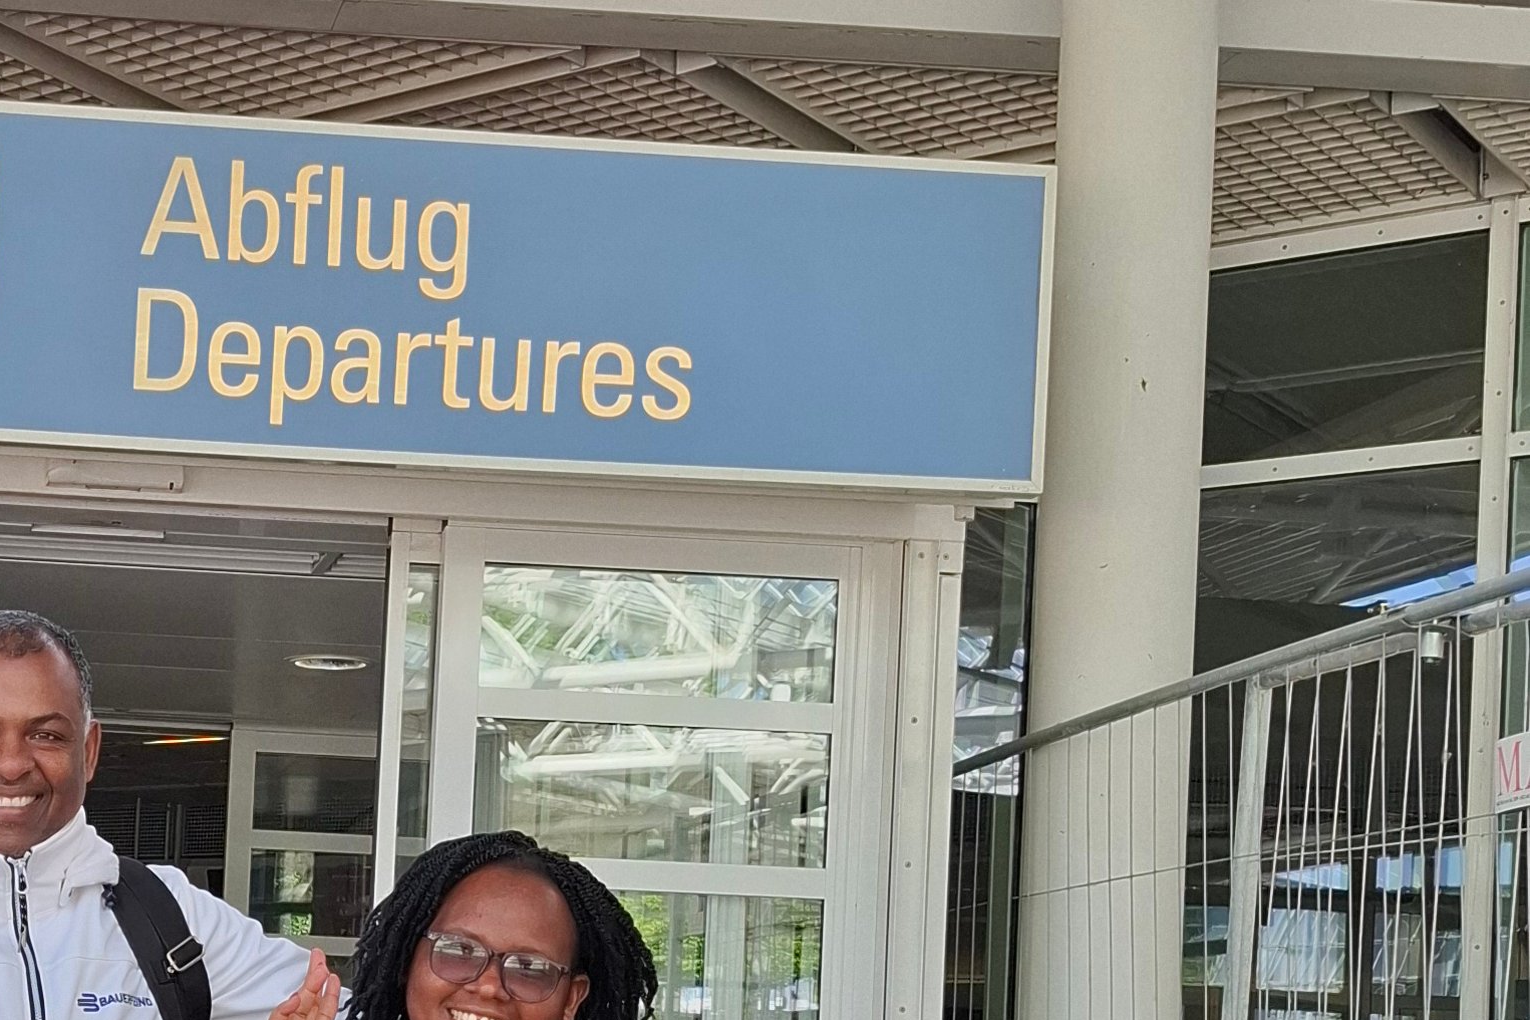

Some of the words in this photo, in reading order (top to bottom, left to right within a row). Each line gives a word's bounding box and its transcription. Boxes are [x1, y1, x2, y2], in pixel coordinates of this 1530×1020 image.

[142, 157, 469, 300] Abflug
[134, 290, 693, 426] Departures
[1497, 740, 1530, 796] M
